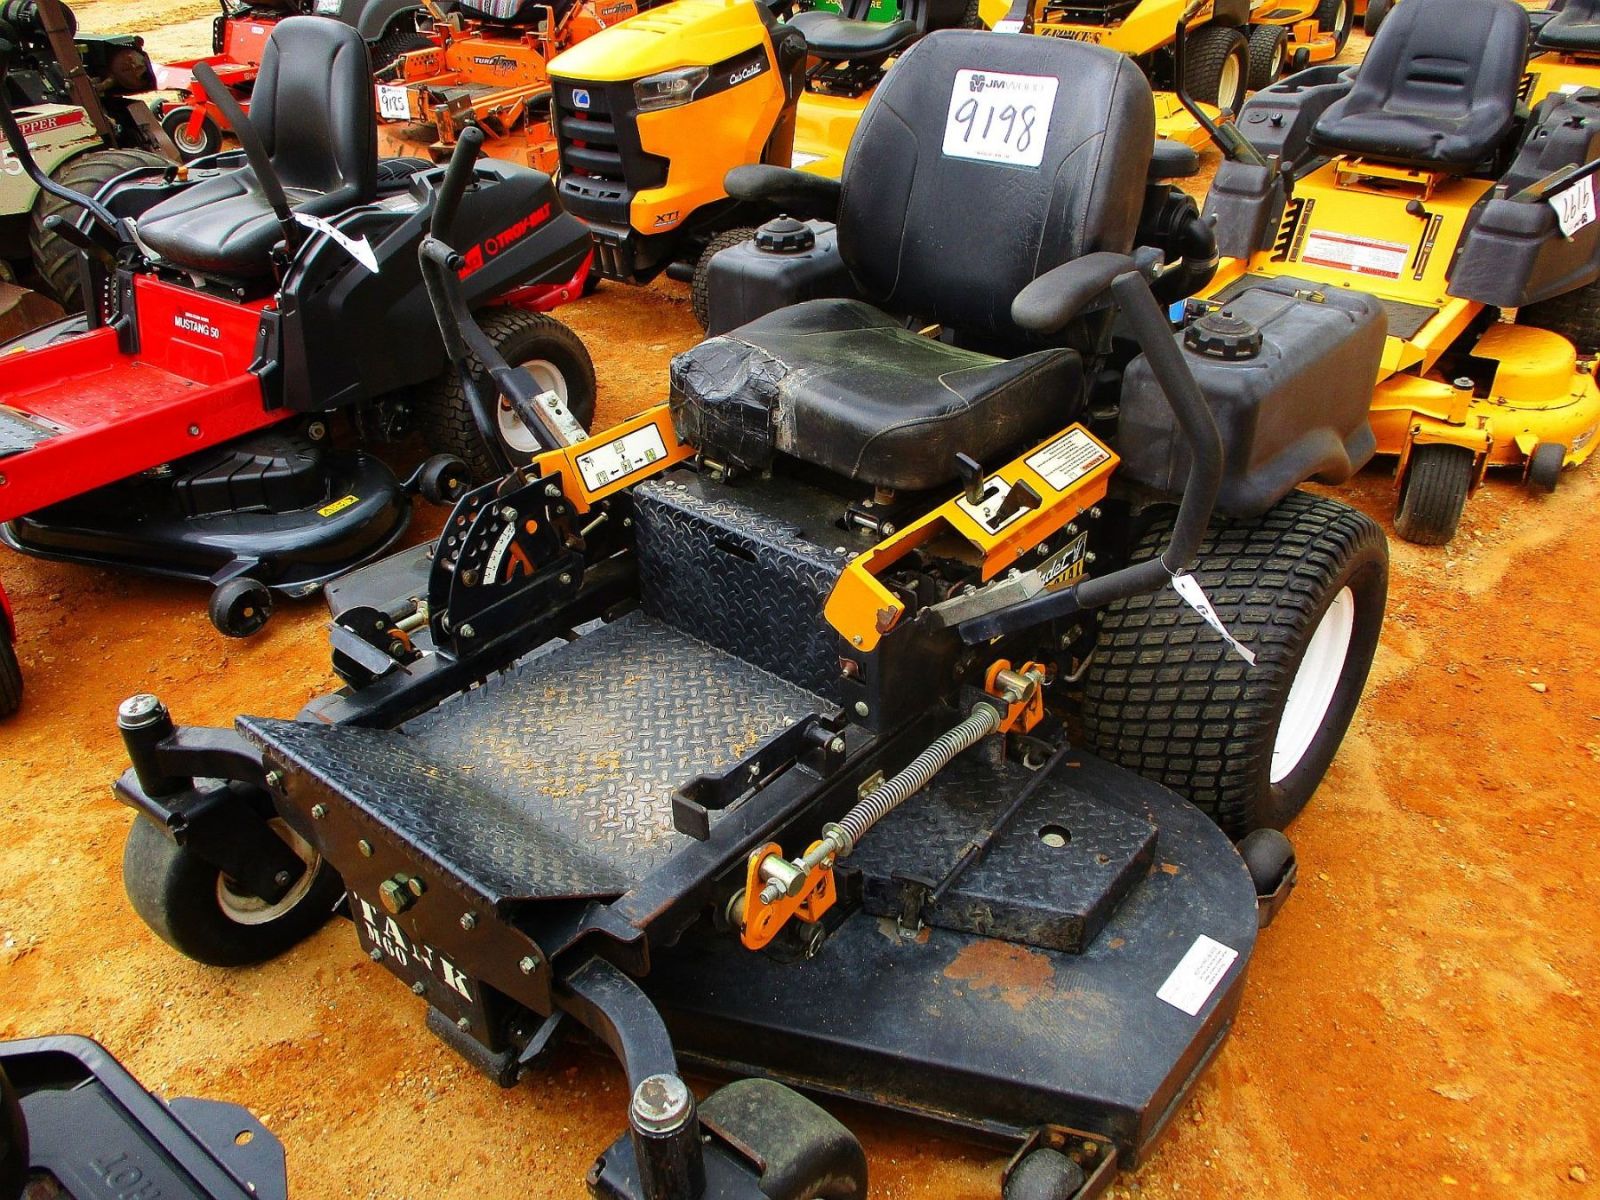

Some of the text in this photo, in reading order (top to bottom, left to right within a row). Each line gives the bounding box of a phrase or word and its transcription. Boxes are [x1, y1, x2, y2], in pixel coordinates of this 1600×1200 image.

[955, 98, 1036, 152] 9198
[495, 202, 551, 249] TROY-BILT
[174, 315, 209, 336] MUSTANG
[210, 327, 220, 339] 50
[353, 891, 473, 1003] TANK
[365, 921, 408, 966] M60
